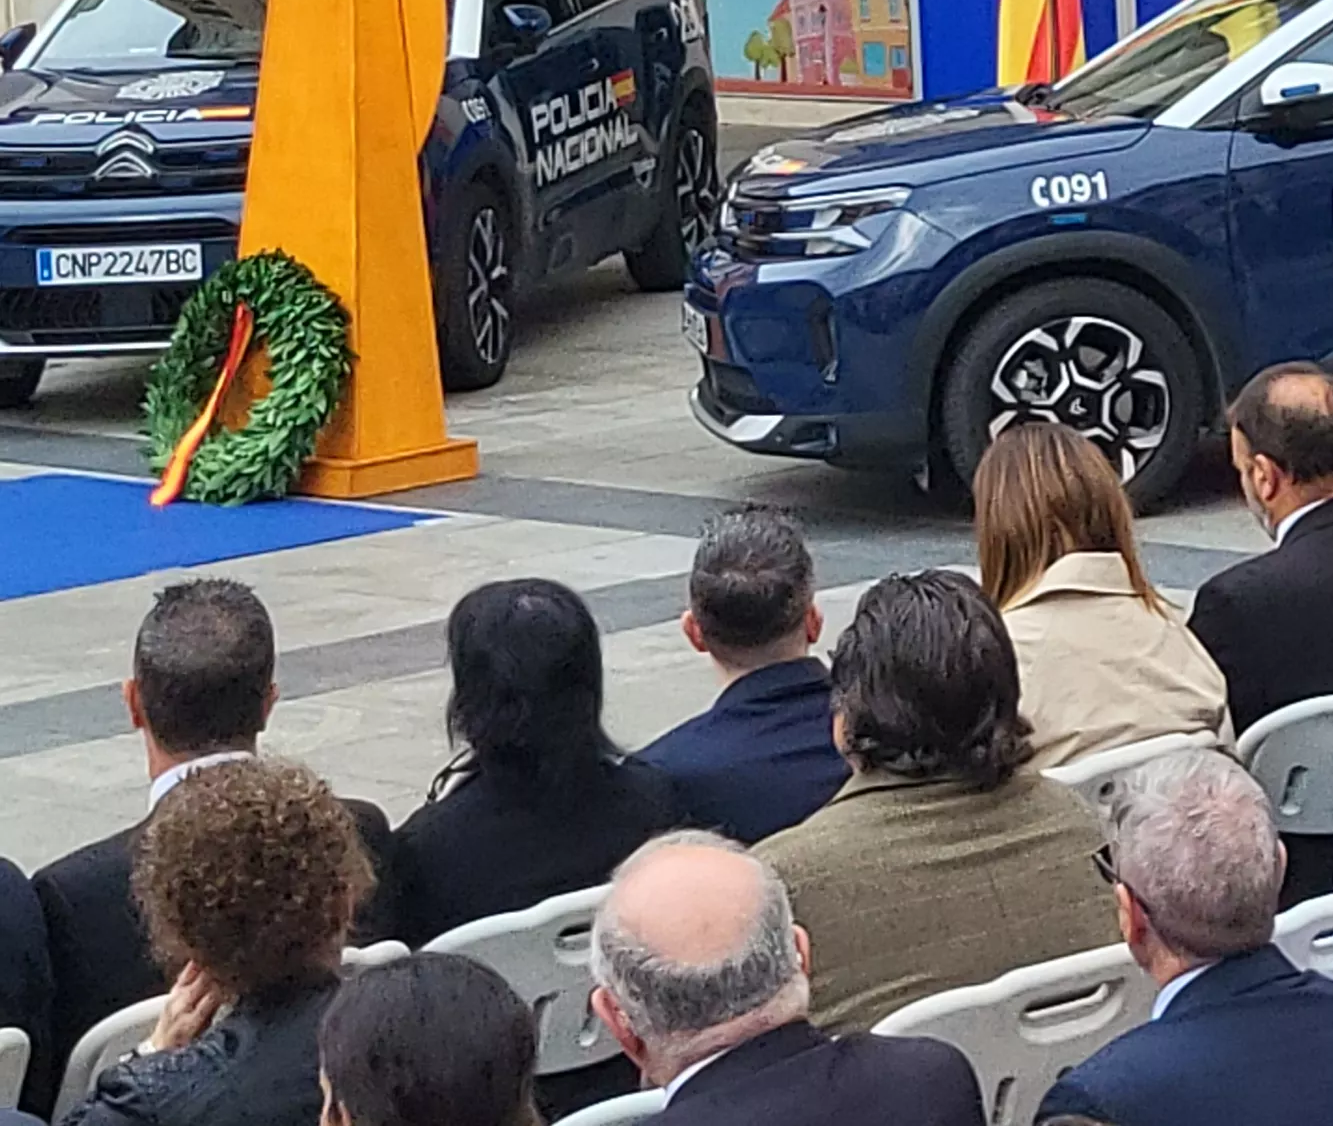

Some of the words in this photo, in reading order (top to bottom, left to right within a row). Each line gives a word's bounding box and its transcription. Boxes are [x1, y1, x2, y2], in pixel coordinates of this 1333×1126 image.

[31, 108, 203, 125] POLICIA
[530, 76, 619, 144] POLICIA
[535, 111, 639, 188] NACIONAL
[1030, 170, 1108, 207] C091
